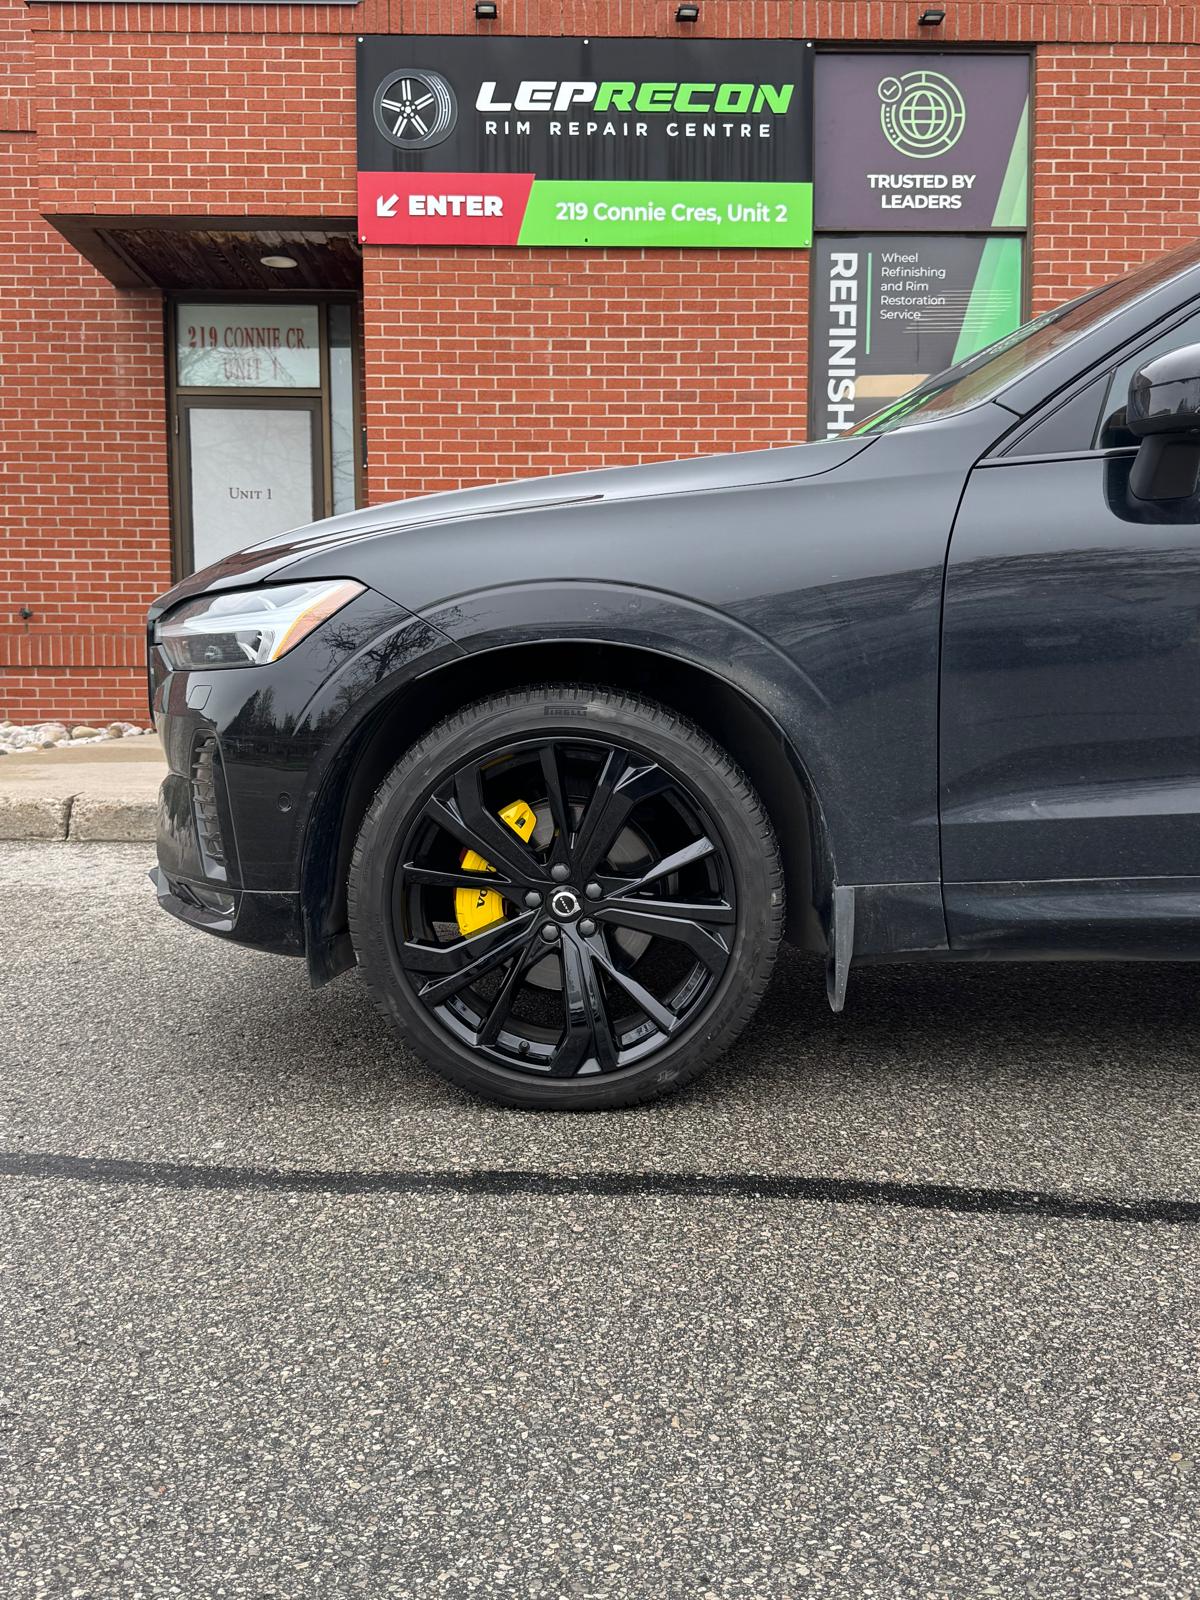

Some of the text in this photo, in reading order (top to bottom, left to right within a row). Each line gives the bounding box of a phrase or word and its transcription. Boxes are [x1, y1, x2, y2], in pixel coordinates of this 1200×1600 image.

[475, 81, 794, 114] LEPRECON
[485, 121, 771, 138] RIM REPAIR CENTRE
[867, 174, 976, 189] TRUSTED BY
[408, 195, 503, 217] ENTER
[881, 195, 962, 209] LEADERS
[555, 202, 787, 225] 219 Connie Cres, Unit 2
[881, 253, 919, 263] Wheel
[881, 267, 946, 279] Refinishing
[881, 281, 929, 291] and Rim
[880, 295, 946, 305] Restoration
[880, 309, 921, 320] Service
[188, 326, 310, 349] 219 CONNIE CR.
[827, 253, 858, 438] REFINISH
[223, 357, 262, 380] UNIT
[267, 488, 273, 500] 1
